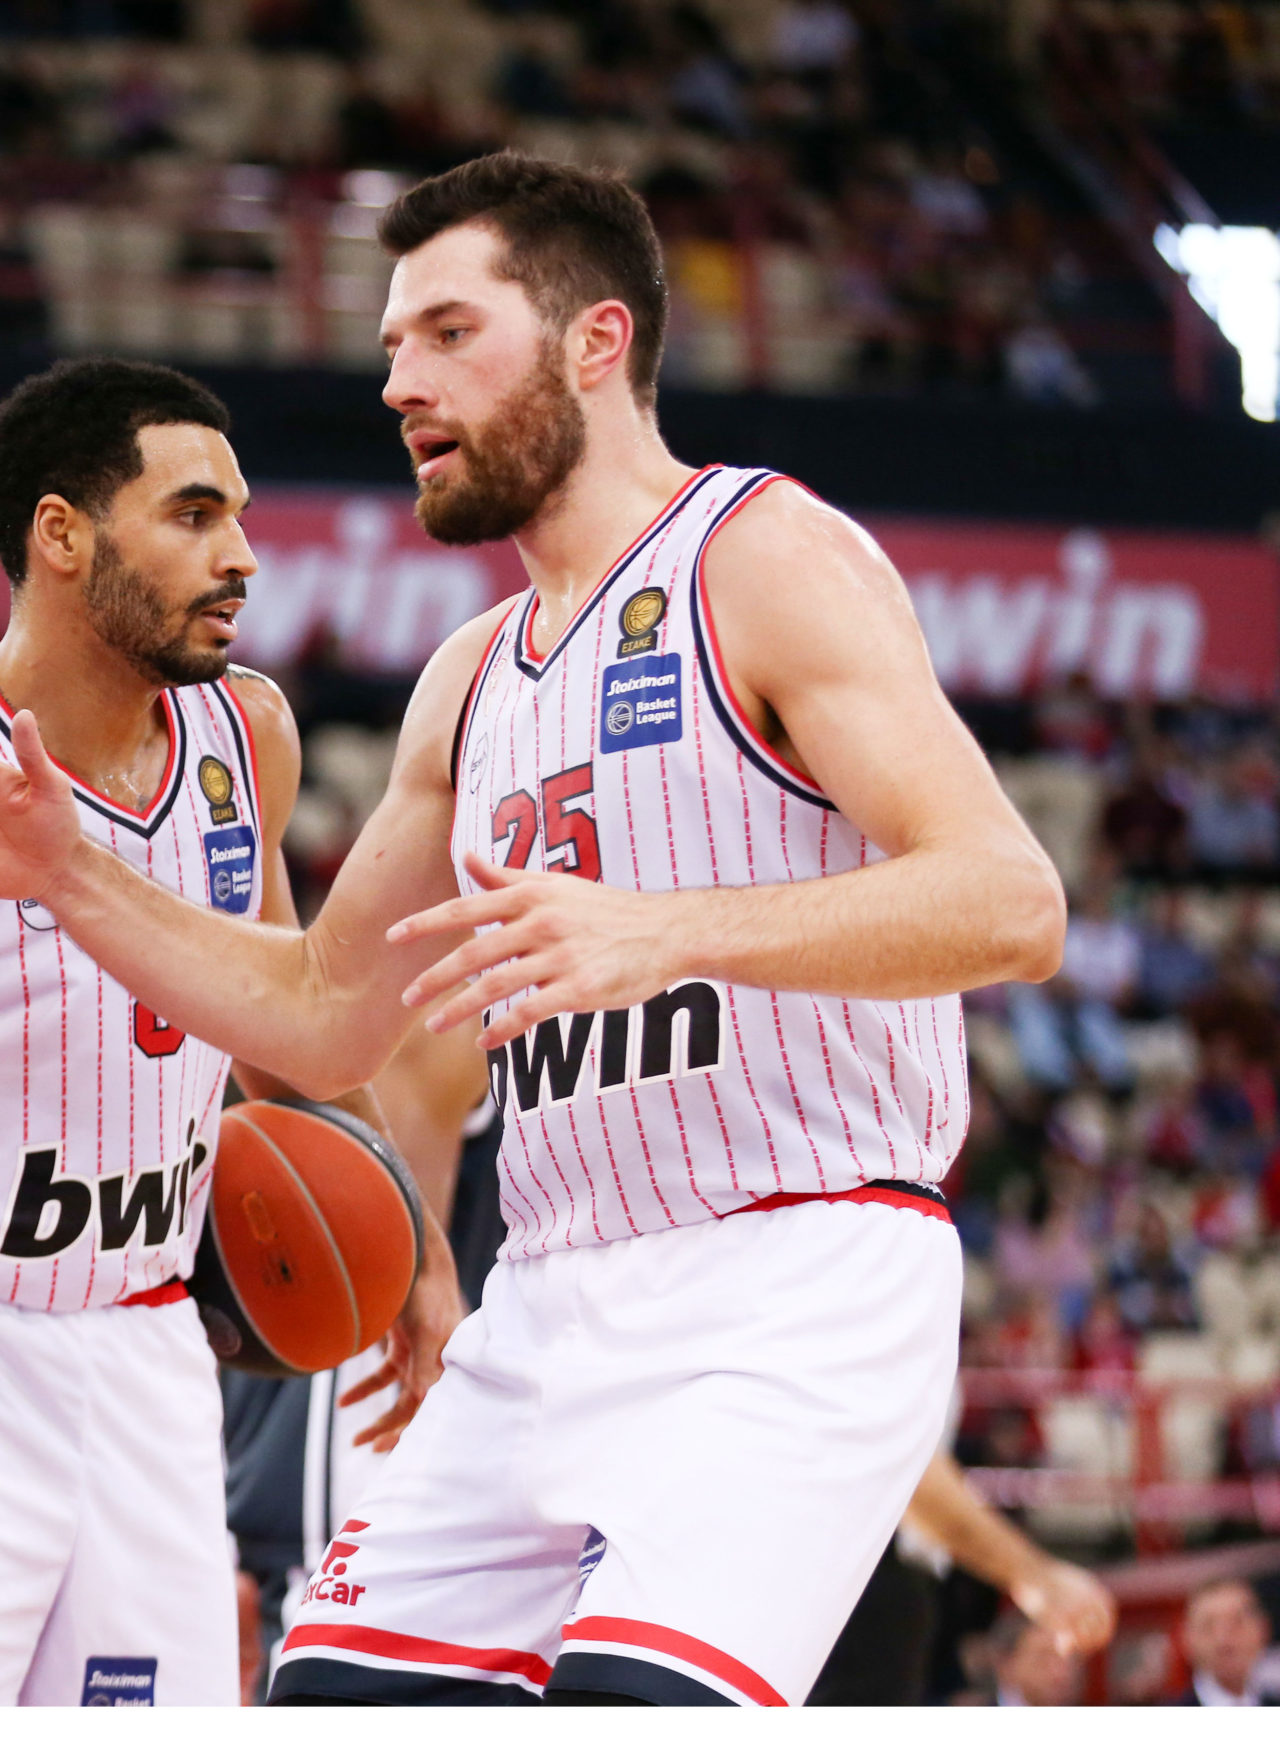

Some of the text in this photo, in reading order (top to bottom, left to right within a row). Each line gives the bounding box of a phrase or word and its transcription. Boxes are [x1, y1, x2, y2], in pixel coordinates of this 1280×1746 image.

[244, 497, 499, 672] win
[906, 527, 1206, 702] win
[606, 674, 676, 696] Stoiximan
[636, 697, 676, 713] Basket
[636, 710, 676, 725] League
[491, 761, 602, 883] 25
